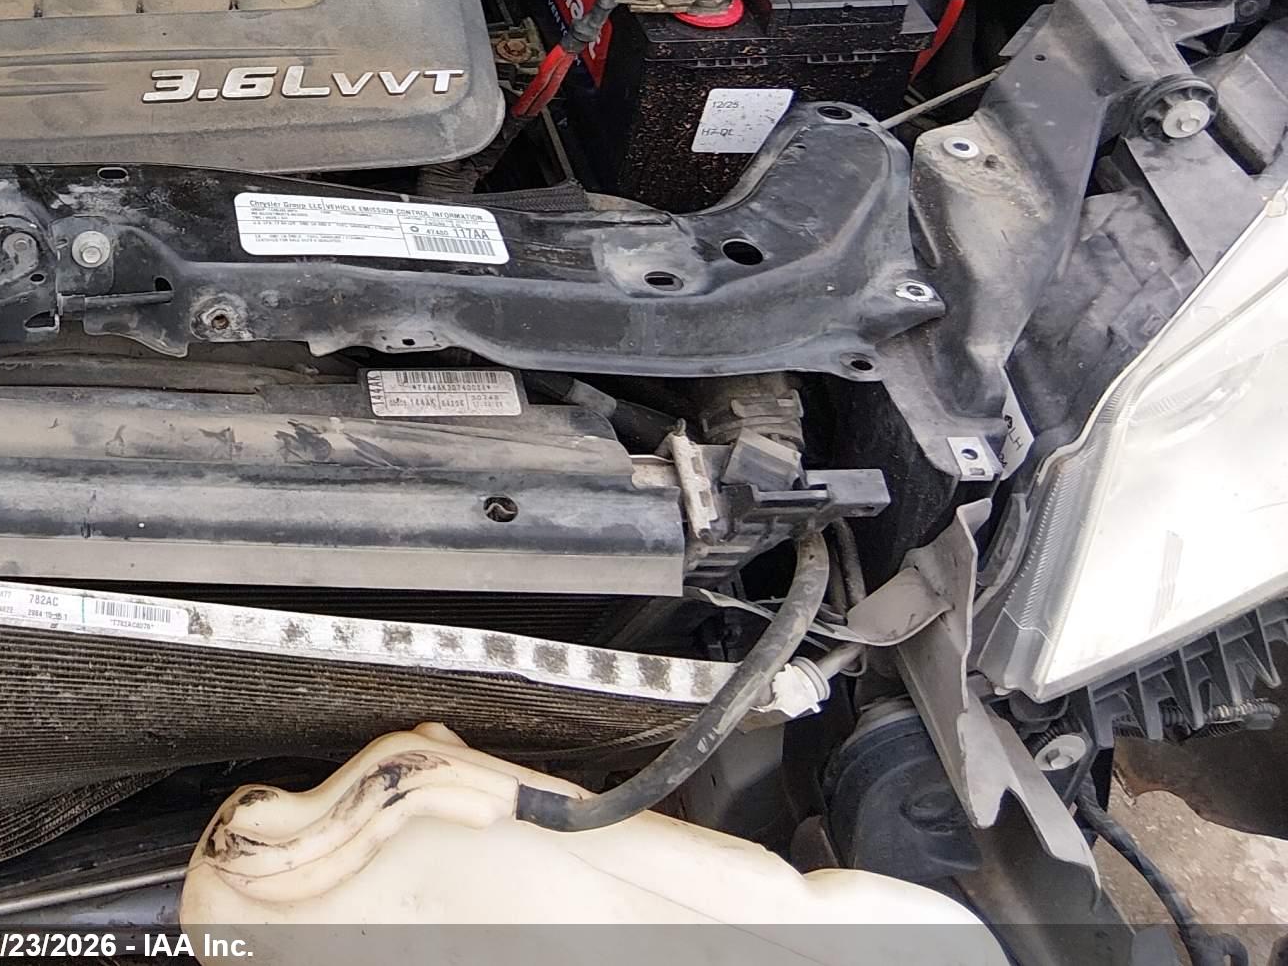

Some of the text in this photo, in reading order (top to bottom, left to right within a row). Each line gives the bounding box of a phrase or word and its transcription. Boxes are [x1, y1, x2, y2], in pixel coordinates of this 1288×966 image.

[713, 100, 739, 109] 12/25
[249, 200, 280, 208] Chrysler
[432, 211, 483, 220] INFORMATION
[454, 228, 490, 240] 117AA
[29, 594, 59, 606] 782AC
